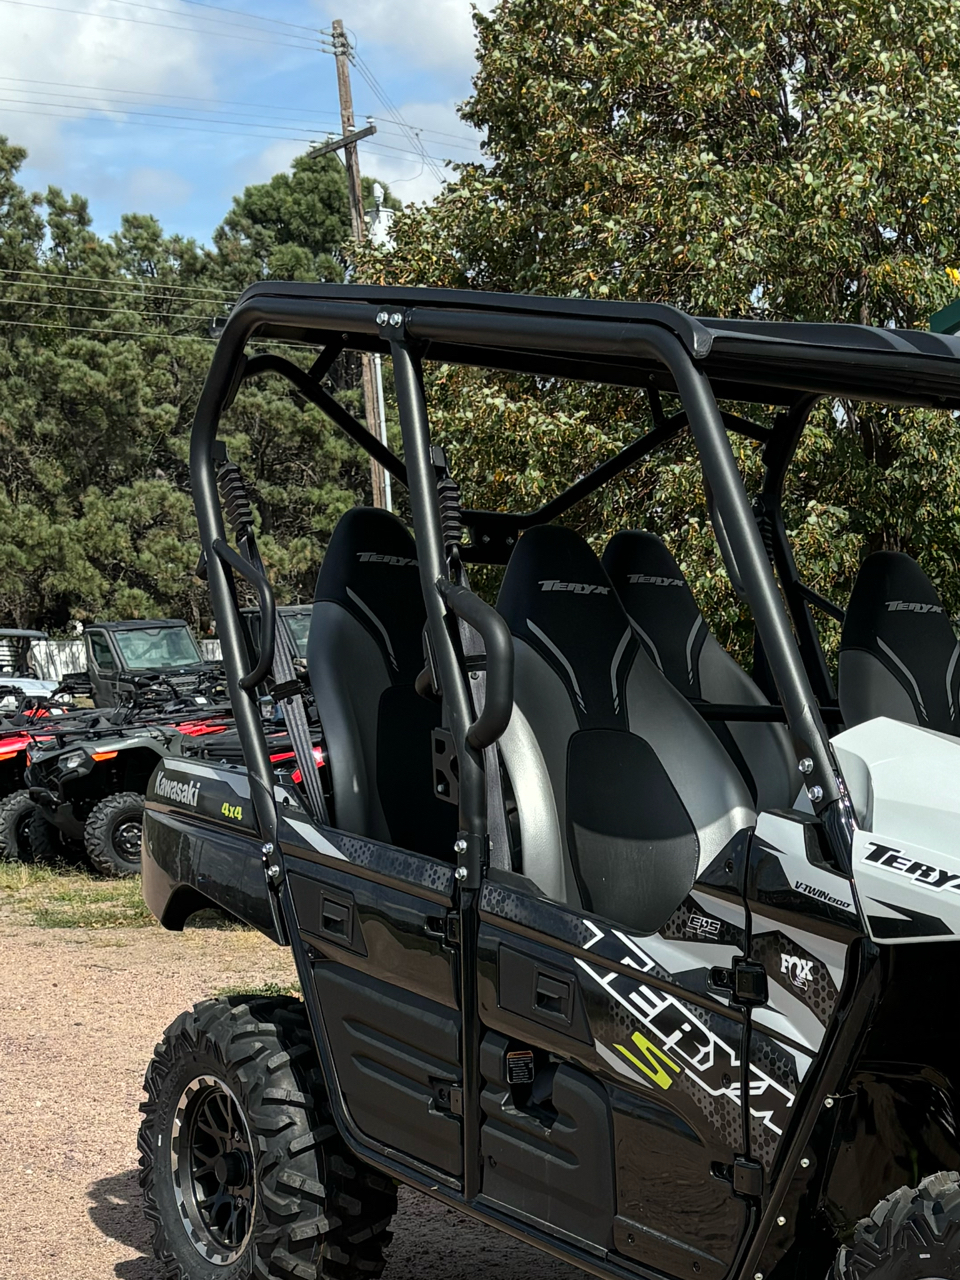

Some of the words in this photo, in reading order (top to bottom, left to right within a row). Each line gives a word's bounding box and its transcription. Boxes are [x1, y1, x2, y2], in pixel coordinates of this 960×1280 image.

[154, 771, 200, 807] Kawasaki
[221, 802, 243, 821] 4x4
[688, 914, 721, 934] EPS
[780, 953, 814, 986] FOX
